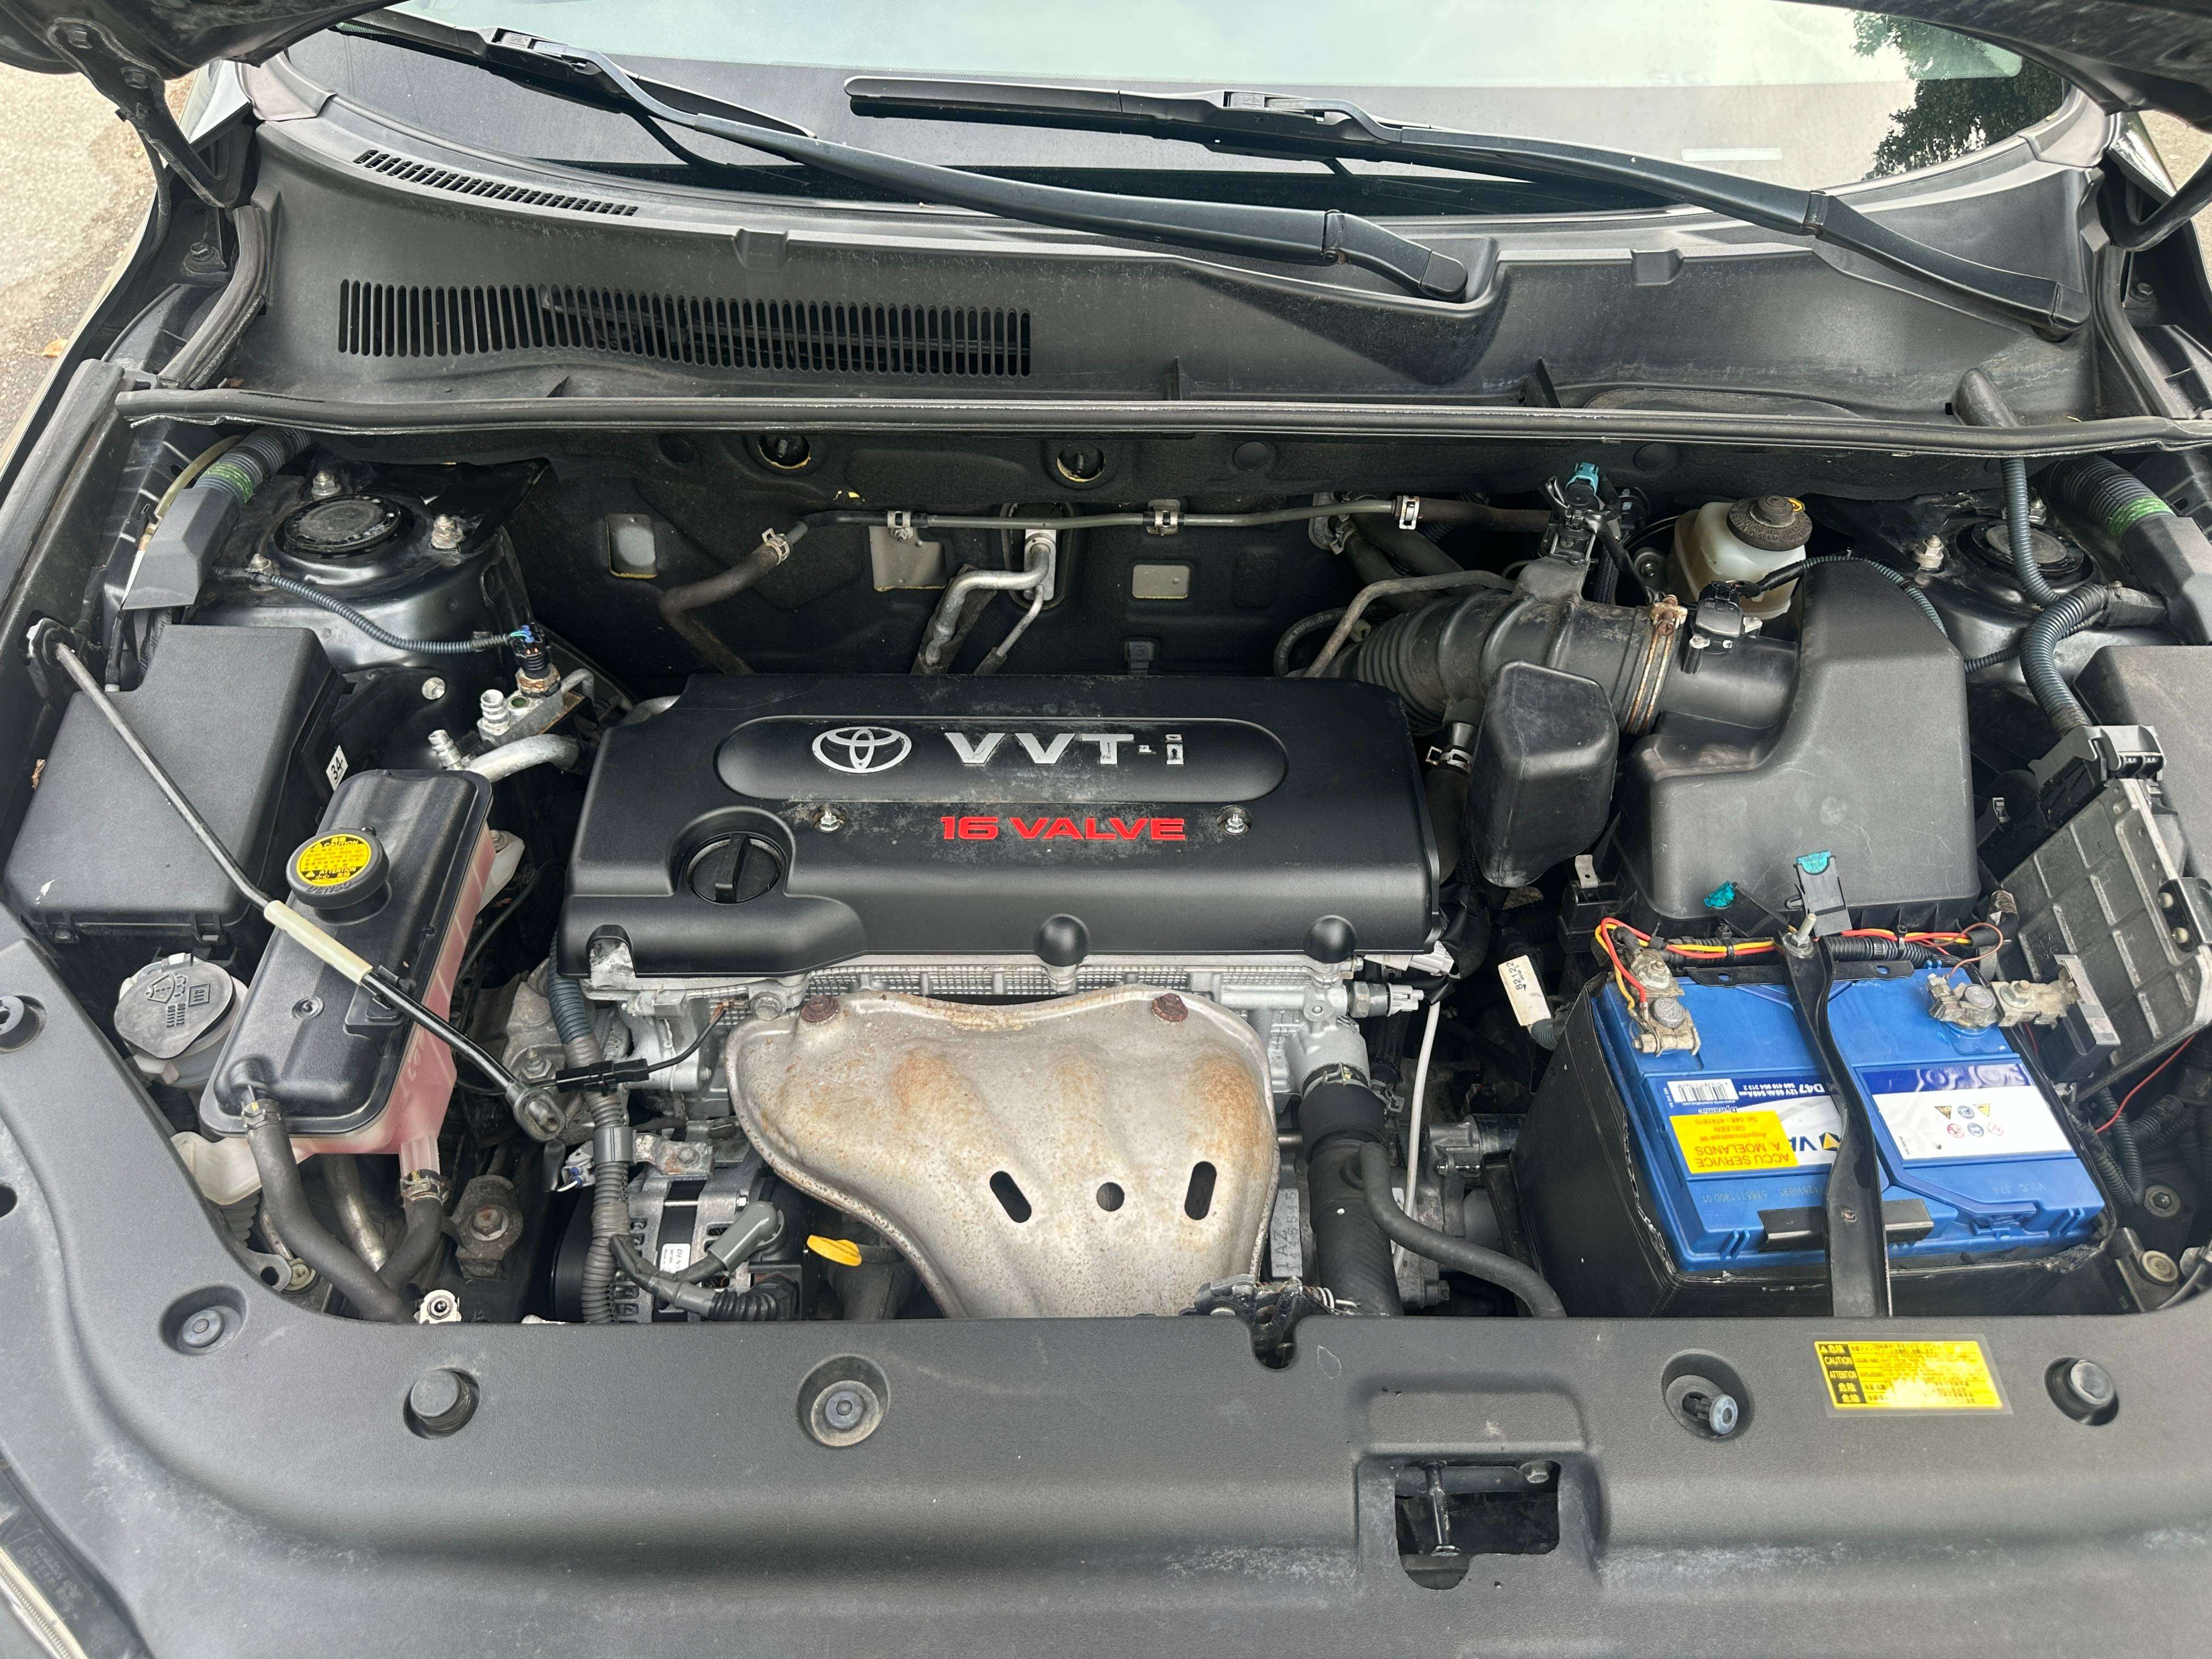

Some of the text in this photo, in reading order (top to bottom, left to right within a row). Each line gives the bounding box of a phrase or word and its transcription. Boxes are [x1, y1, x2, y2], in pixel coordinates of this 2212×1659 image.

[945, 731, 1185, 766] VVT-i
[941, 816, 1187, 842] 16 VALVE
[307, 882, 351, 894] DENSO
[1506, 961, 1523, 991] 82122
[1798, 1083, 1825, 1094] D47
[1698, 1105, 1737, 1114] Dynamic
[1695, 1142, 1781, 1156] A. MOELANDS
[1696, 1153, 1790, 1168] ACCU SERVICE
[1824, 1356, 1853, 1365] CAUTION
[1829, 1370, 1858, 1379] ATTENTION
